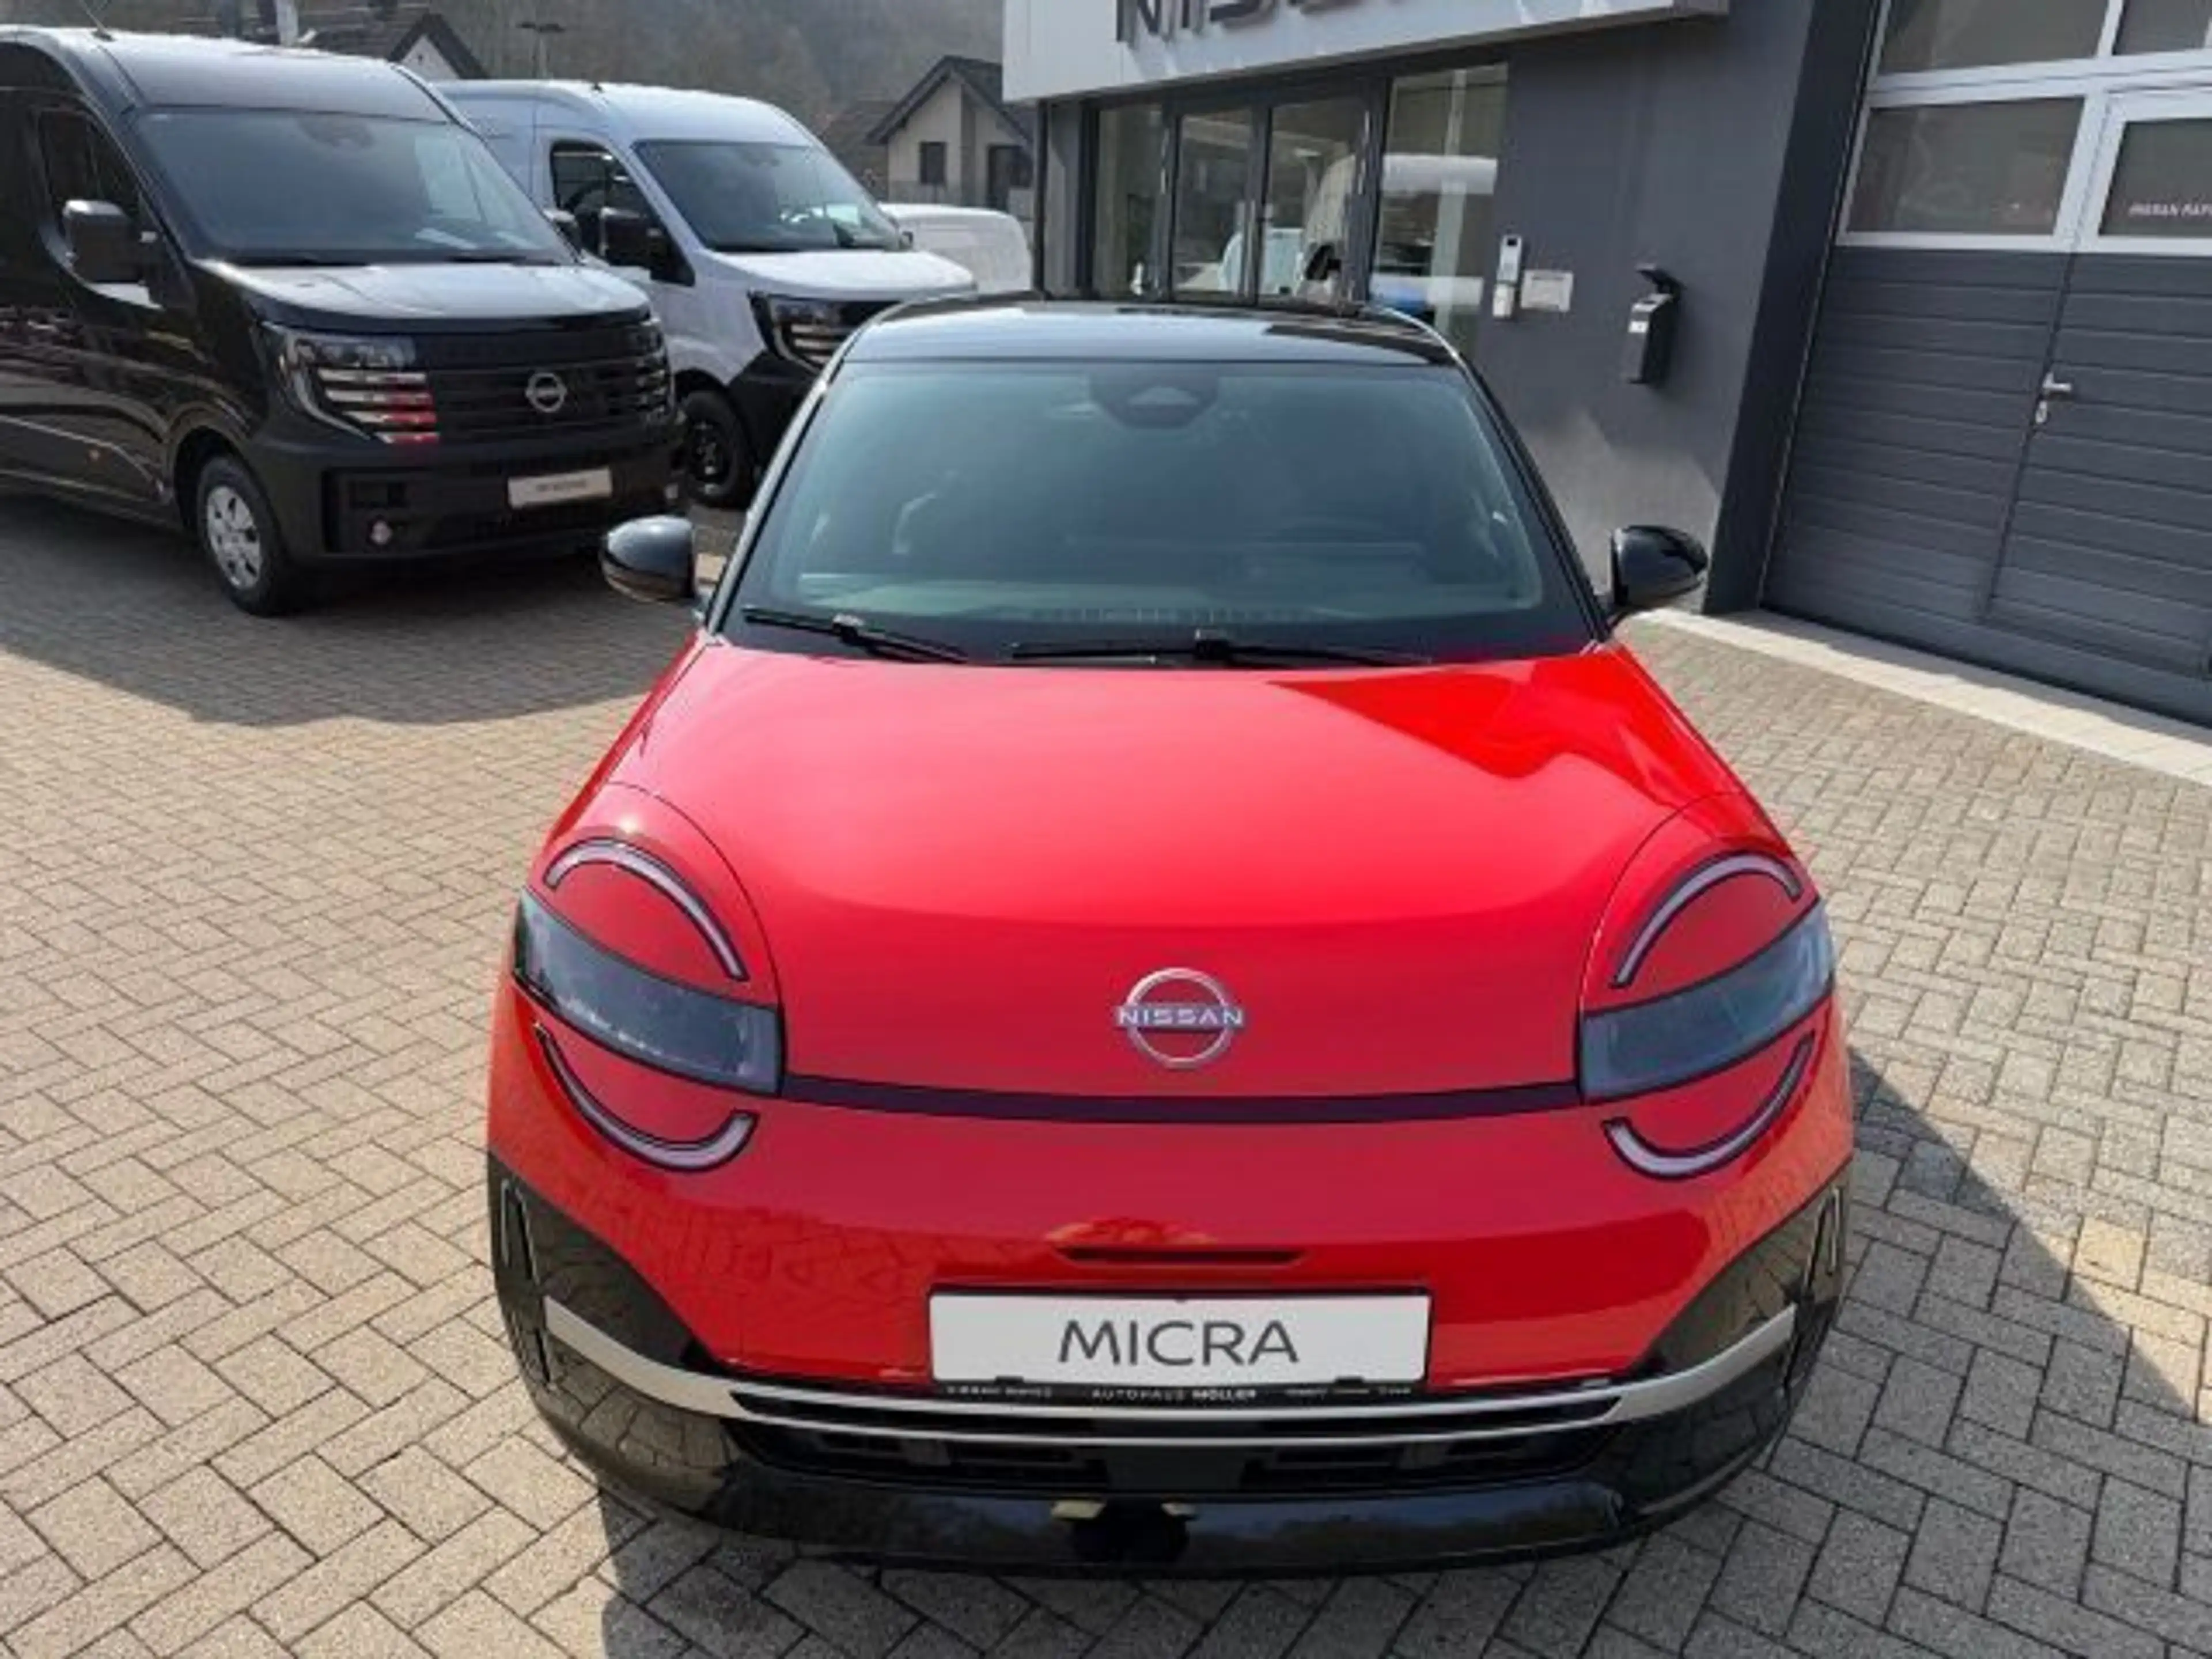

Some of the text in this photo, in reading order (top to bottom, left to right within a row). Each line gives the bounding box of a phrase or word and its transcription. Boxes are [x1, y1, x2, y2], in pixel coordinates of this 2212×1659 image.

[1118, 1007, 1244, 1025] NISSAN
[1059, 1320, 1299, 1366] MICRA
[1091, 1389, 1186, 1400] AUTOHAUS
